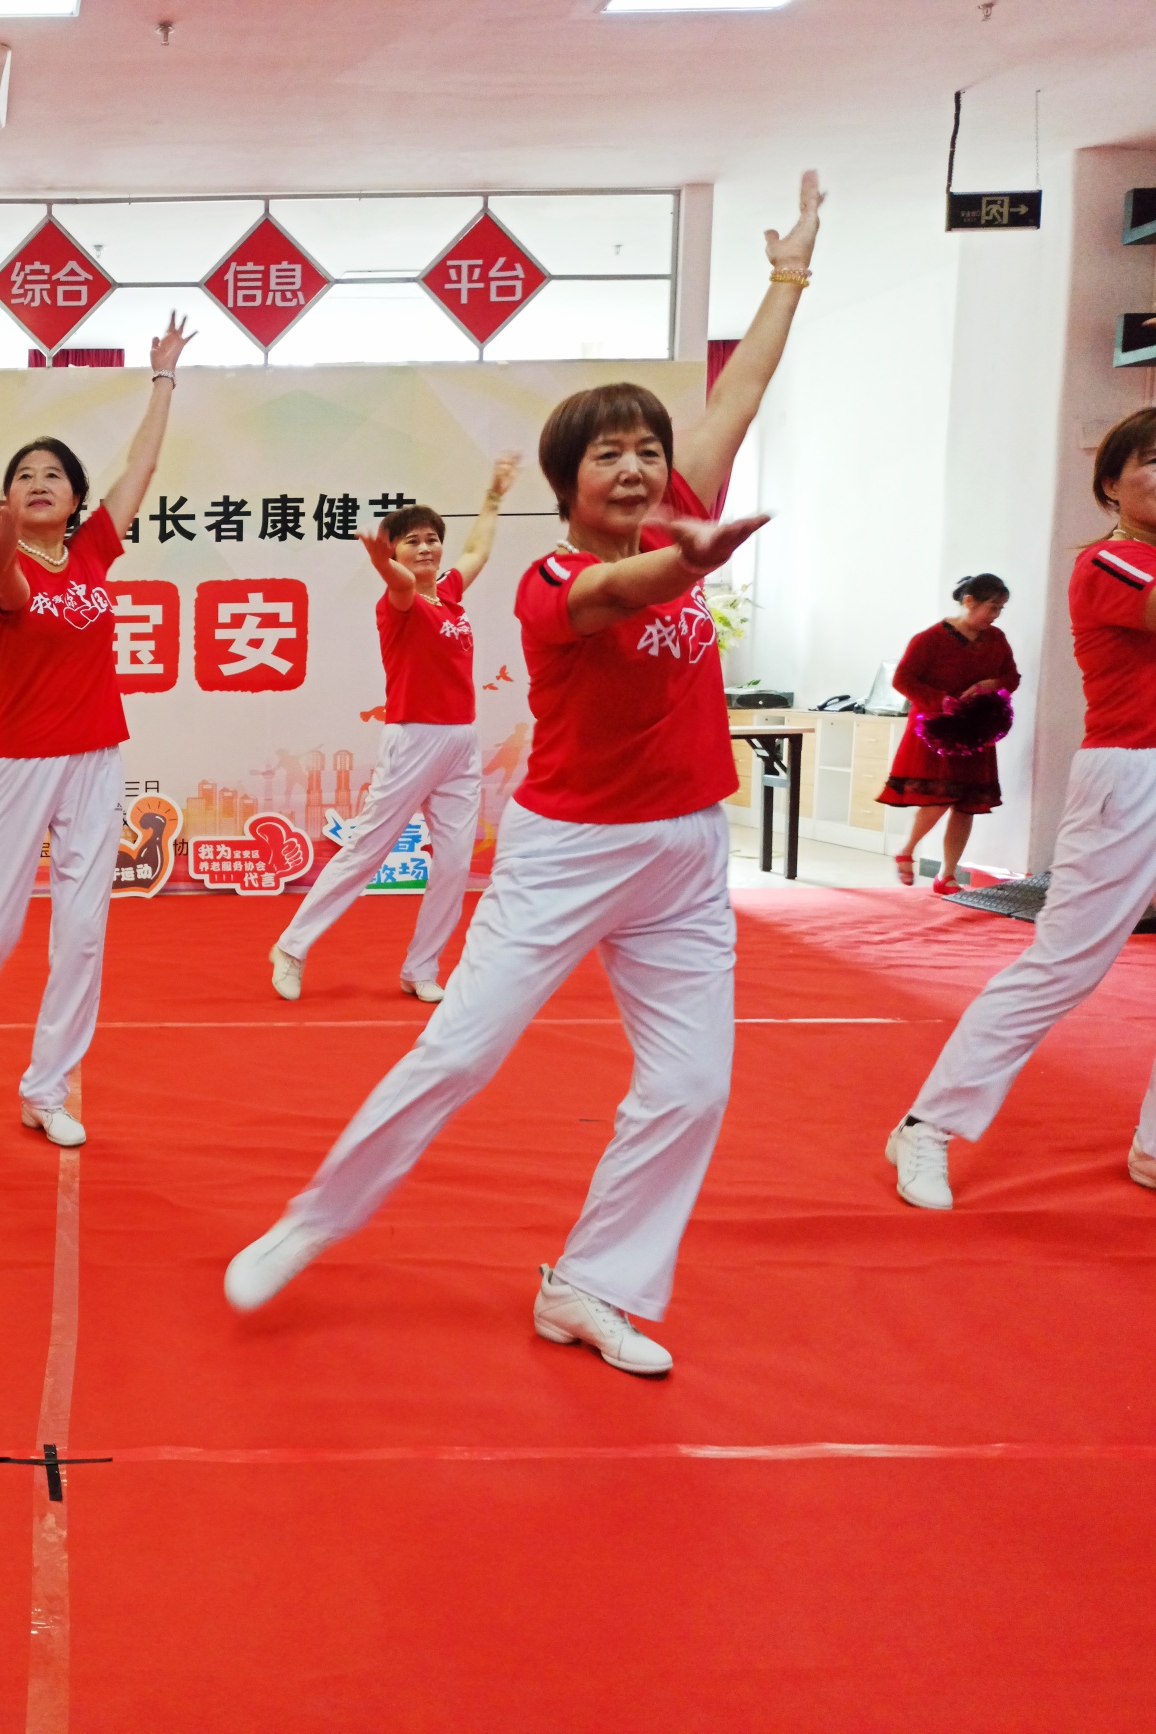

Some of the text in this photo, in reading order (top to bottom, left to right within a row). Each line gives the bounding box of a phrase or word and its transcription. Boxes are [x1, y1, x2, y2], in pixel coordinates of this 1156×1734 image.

[10, 260, 94, 307] 综合
[224, 260, 306, 307] 信息
[444, 256, 525, 302] 平台
[199, 861, 266, 872] 养老服务协会
[243, 872, 276, 888] 代言
